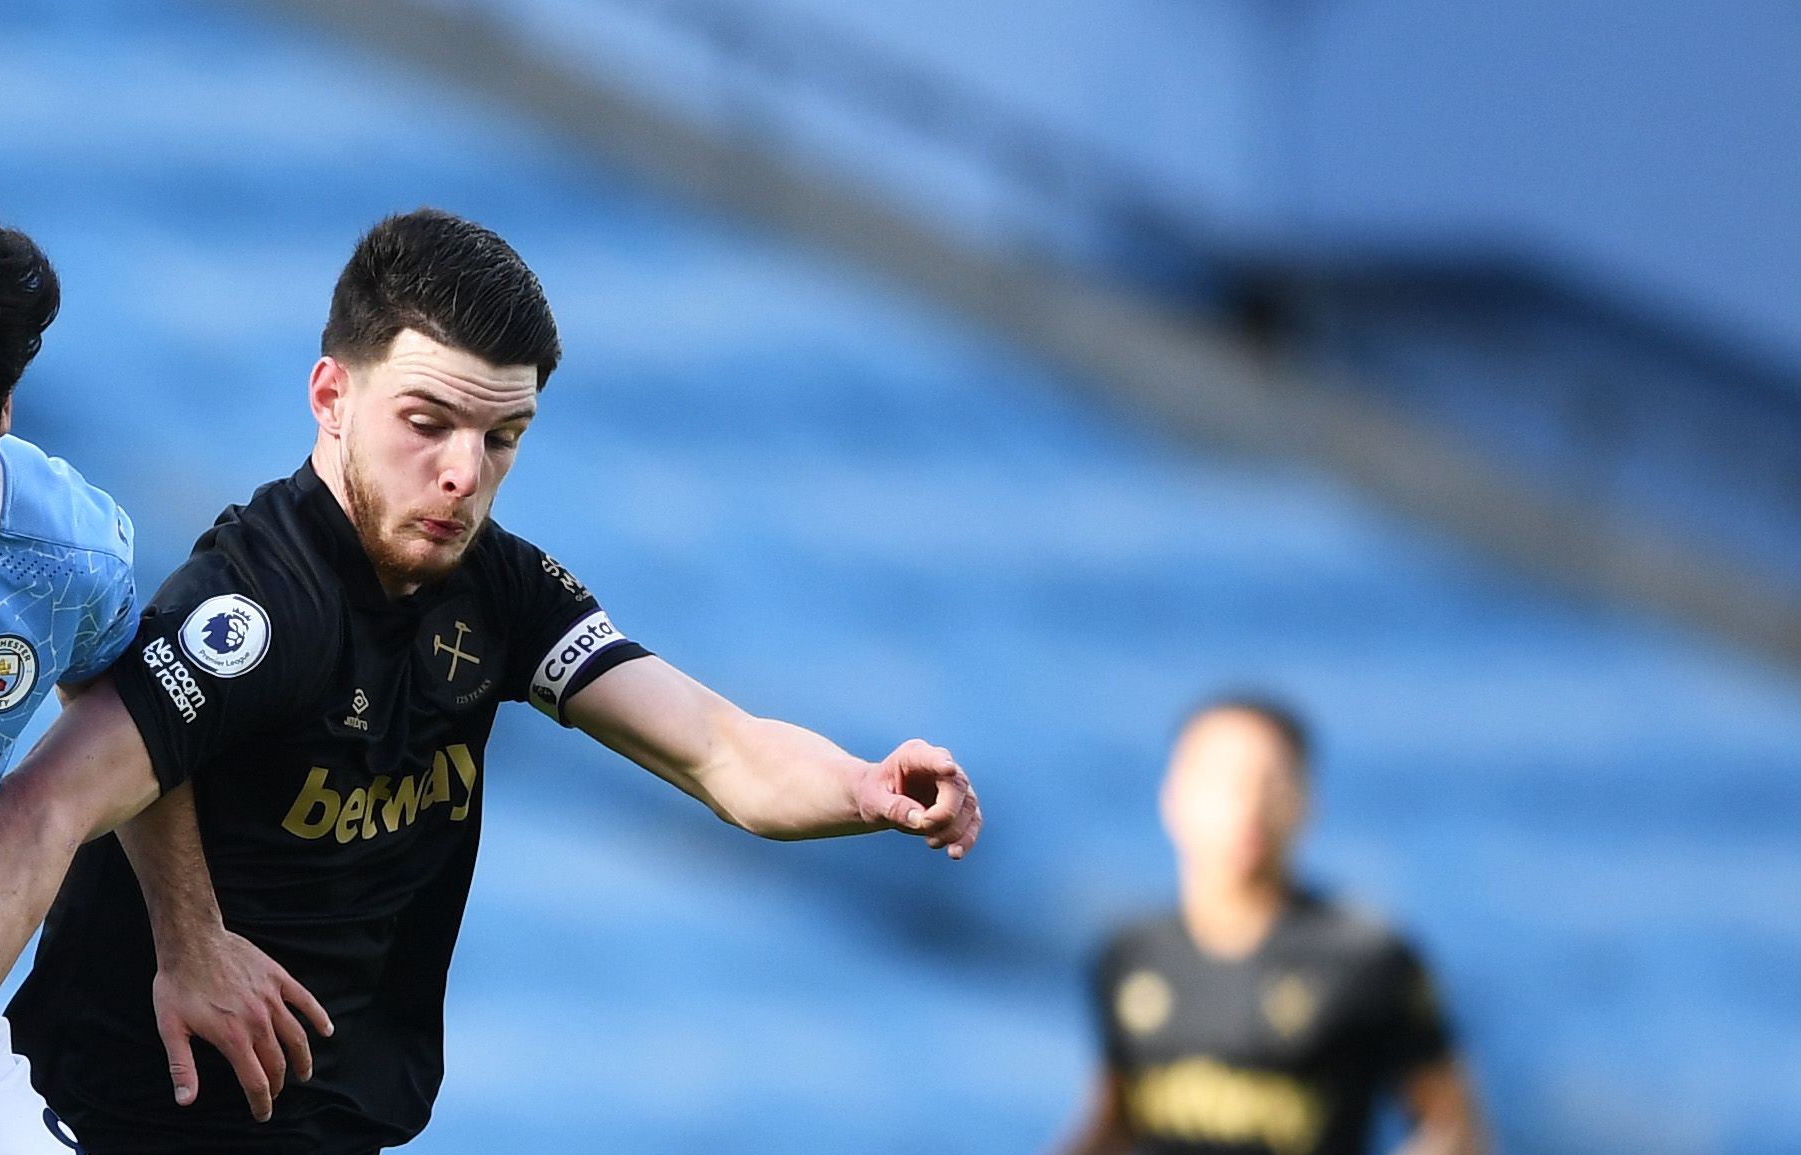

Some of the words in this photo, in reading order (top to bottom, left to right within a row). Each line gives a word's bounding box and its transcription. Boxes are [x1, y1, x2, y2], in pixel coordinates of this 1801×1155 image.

[151, 636, 175, 664] No
[168, 660, 206, 709] room
[155, 668, 197, 724] racism
[280, 743, 477, 845] betway
